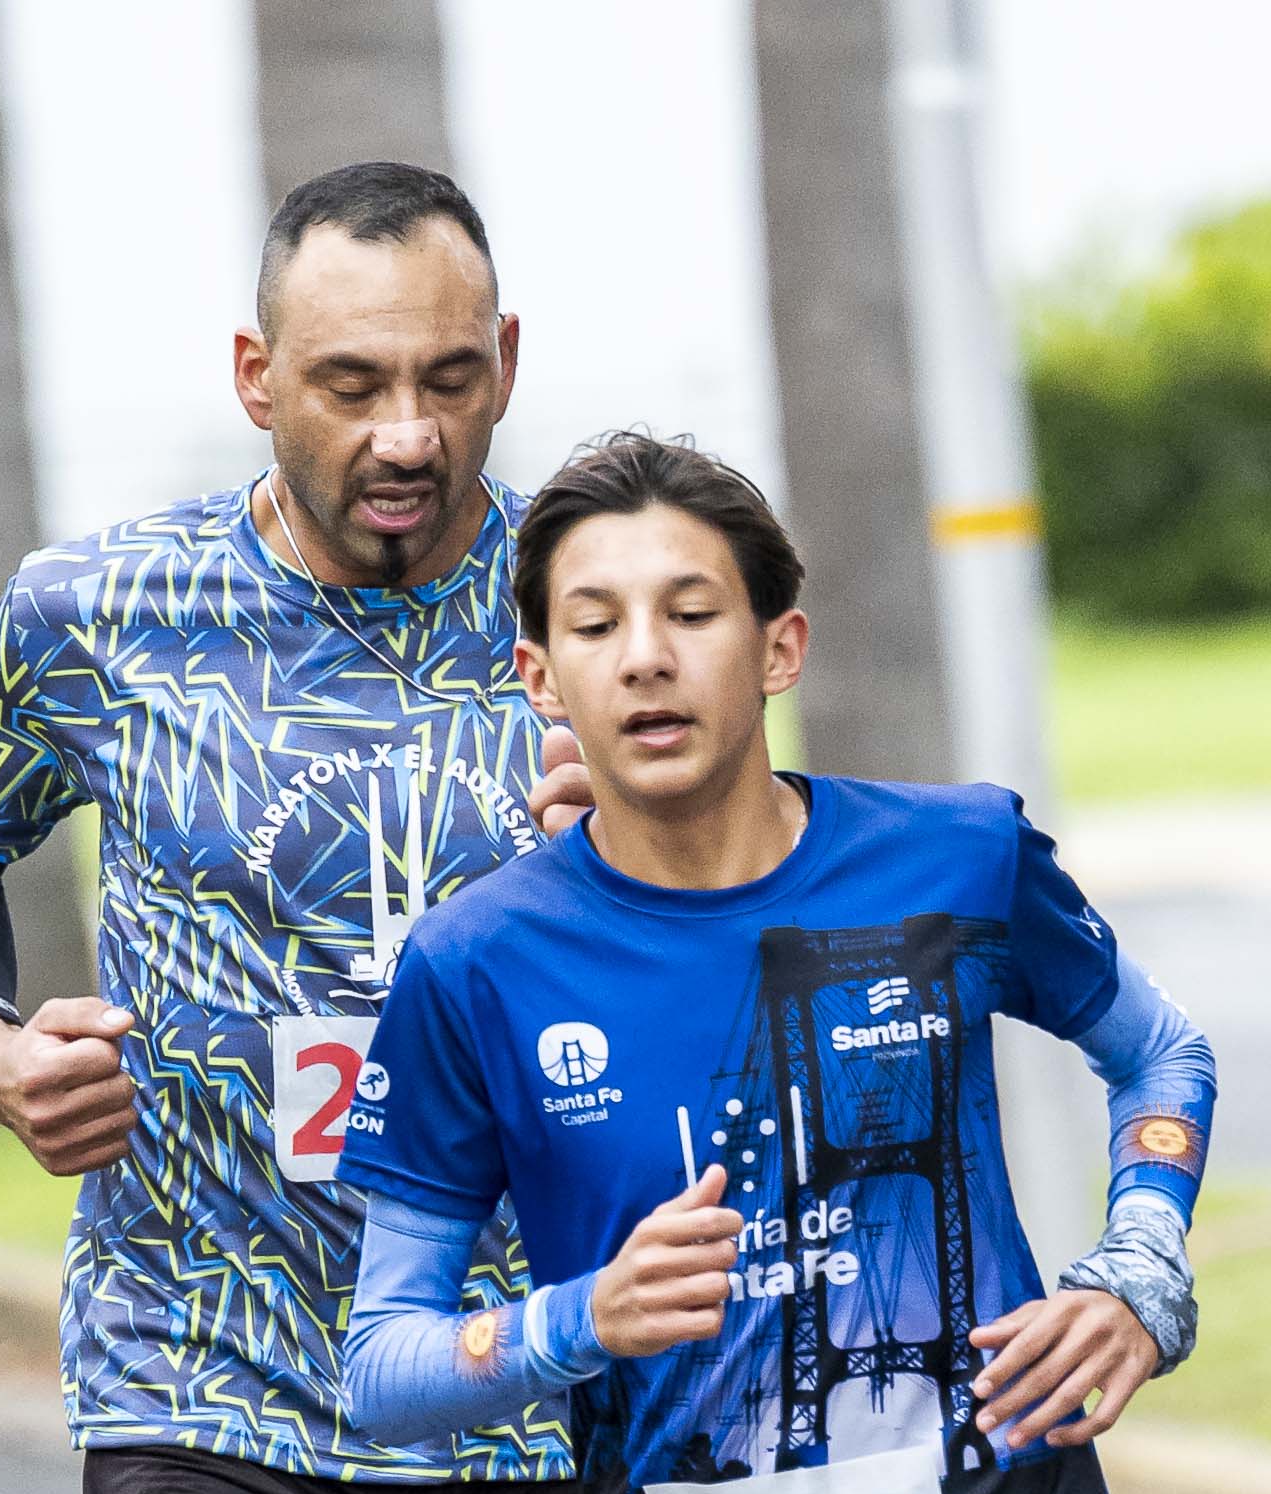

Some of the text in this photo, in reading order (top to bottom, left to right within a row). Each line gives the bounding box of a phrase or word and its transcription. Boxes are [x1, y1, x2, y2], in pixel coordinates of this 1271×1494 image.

[369, 743, 395, 768] X
[403, 743, 437, 774] EL
[831, 1013, 950, 1051] Santa Fe
[542, 1087, 624, 1113] Santa Fe
[347, 1110, 385, 1136] ÓN
[560, 1107, 609, 1126] Capital
[730, 1199, 853, 1253] ría de
[802, 1247, 860, 1291] Fe
